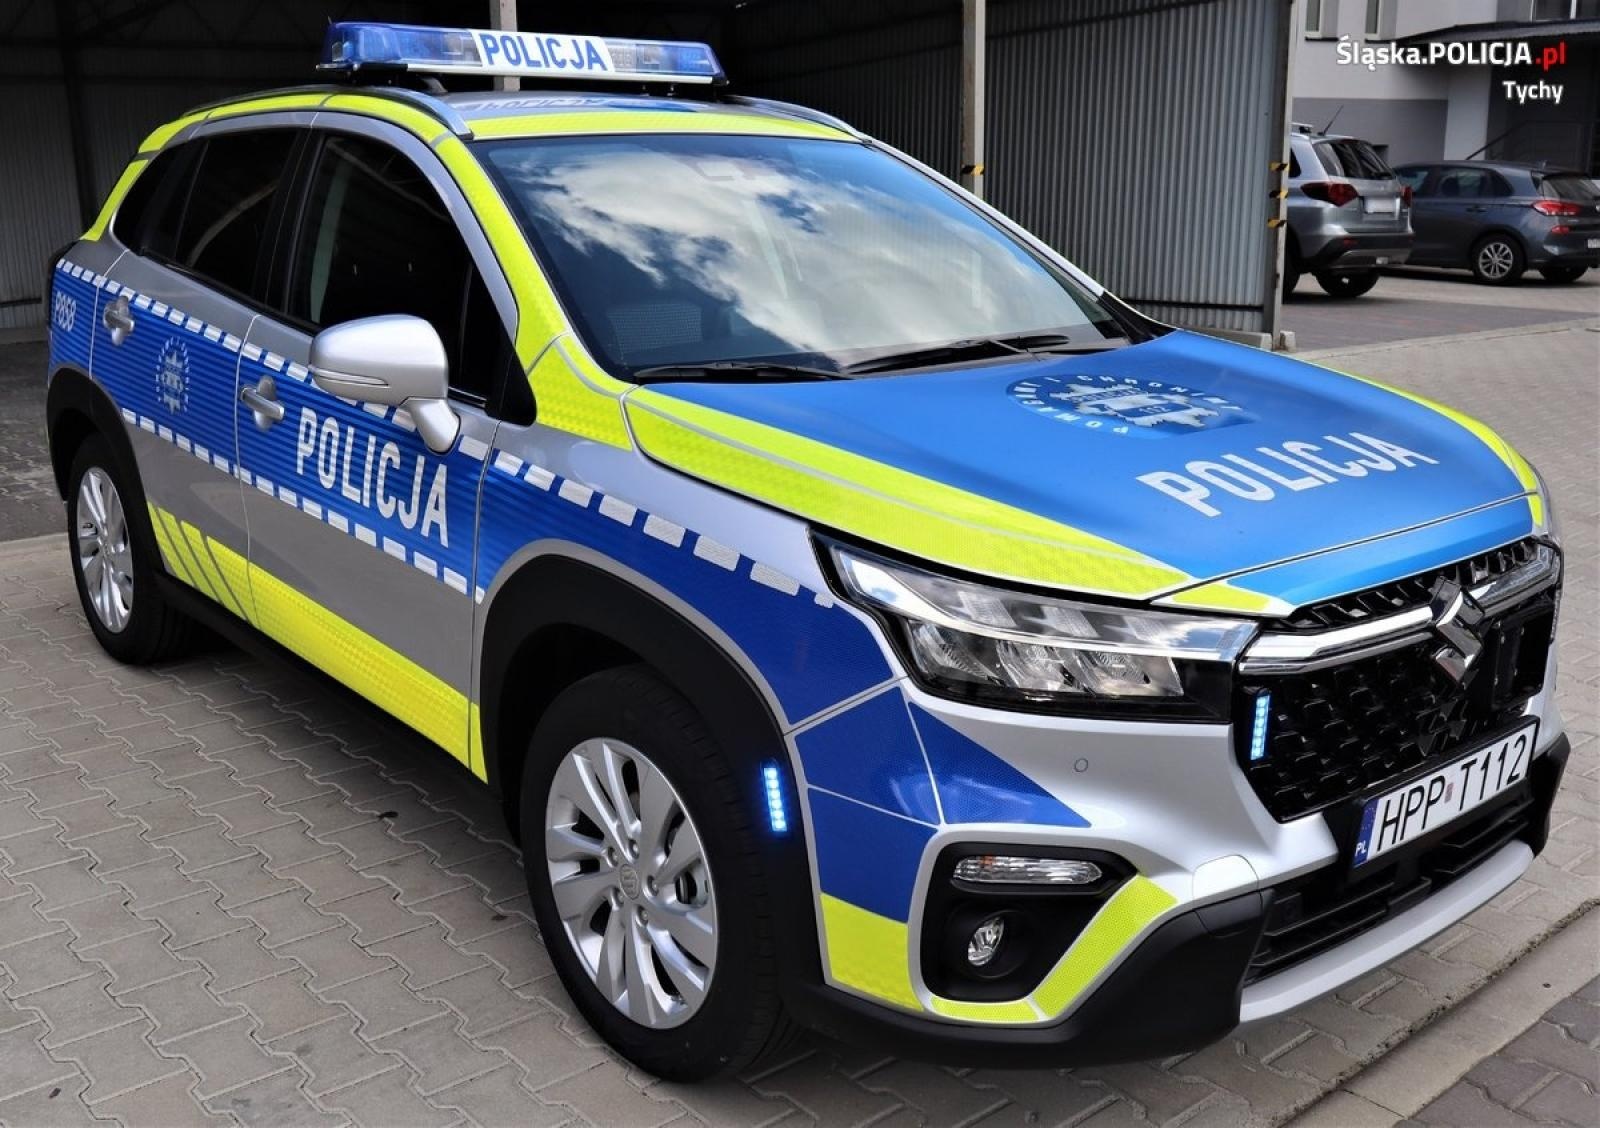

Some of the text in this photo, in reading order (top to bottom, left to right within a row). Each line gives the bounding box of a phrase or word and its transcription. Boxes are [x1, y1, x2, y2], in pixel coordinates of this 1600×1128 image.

[478, 33, 608, 71] POLICJA
[296, 406, 449, 548] POLICJA
[1135, 432, 1440, 518] POLICJA
[1377, 734, 1527, 852] HPP T112
[1355, 840, 1366, 856] PL
